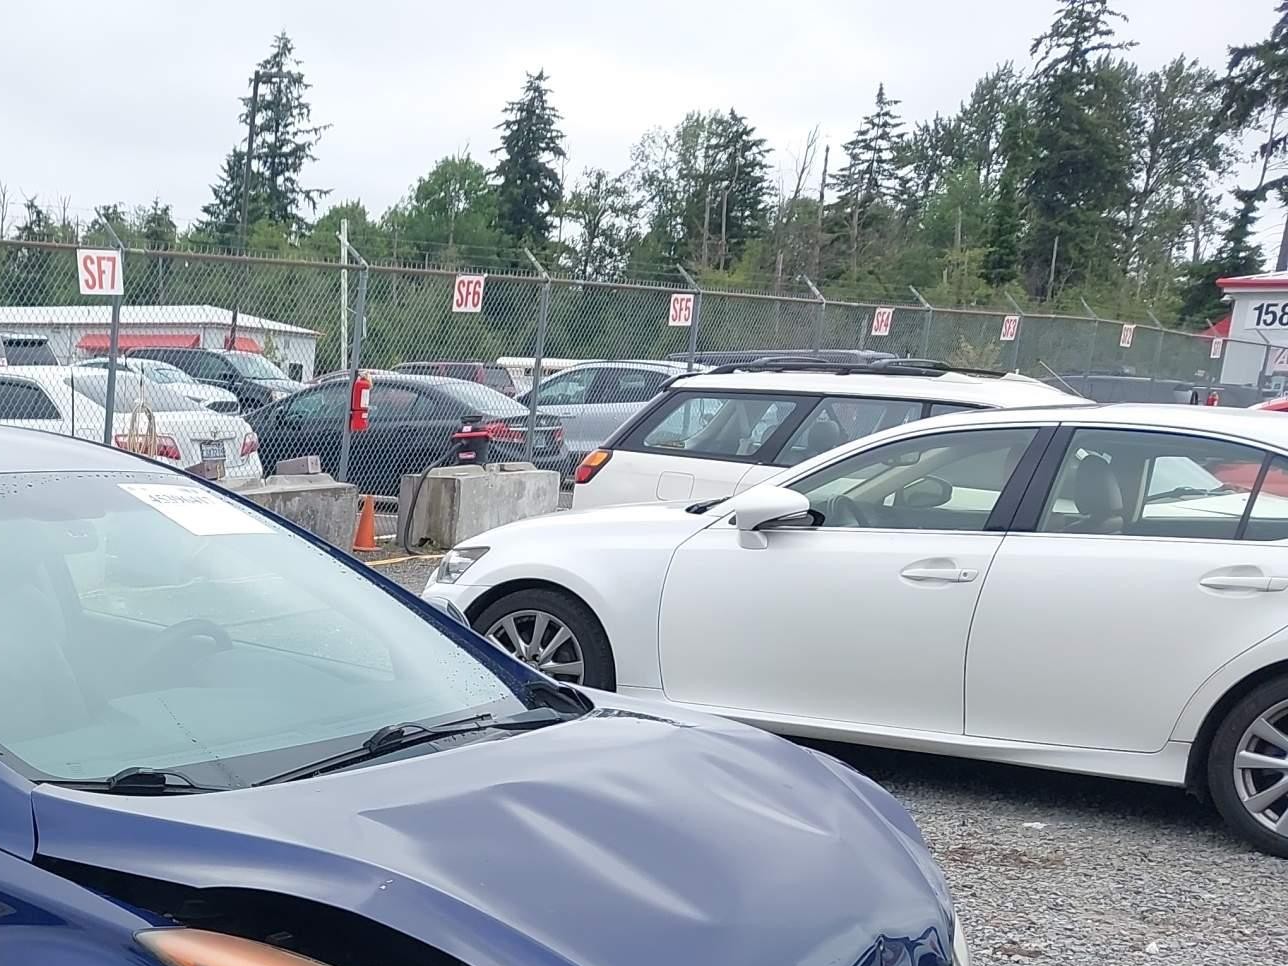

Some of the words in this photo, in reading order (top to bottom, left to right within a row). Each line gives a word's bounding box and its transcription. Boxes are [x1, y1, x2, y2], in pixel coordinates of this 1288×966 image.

[83, 255, 116, 290] SF7
[456, 279, 482, 308] SF6
[672, 297, 692, 322] SF5
[874, 311, 892, 332] SF4
